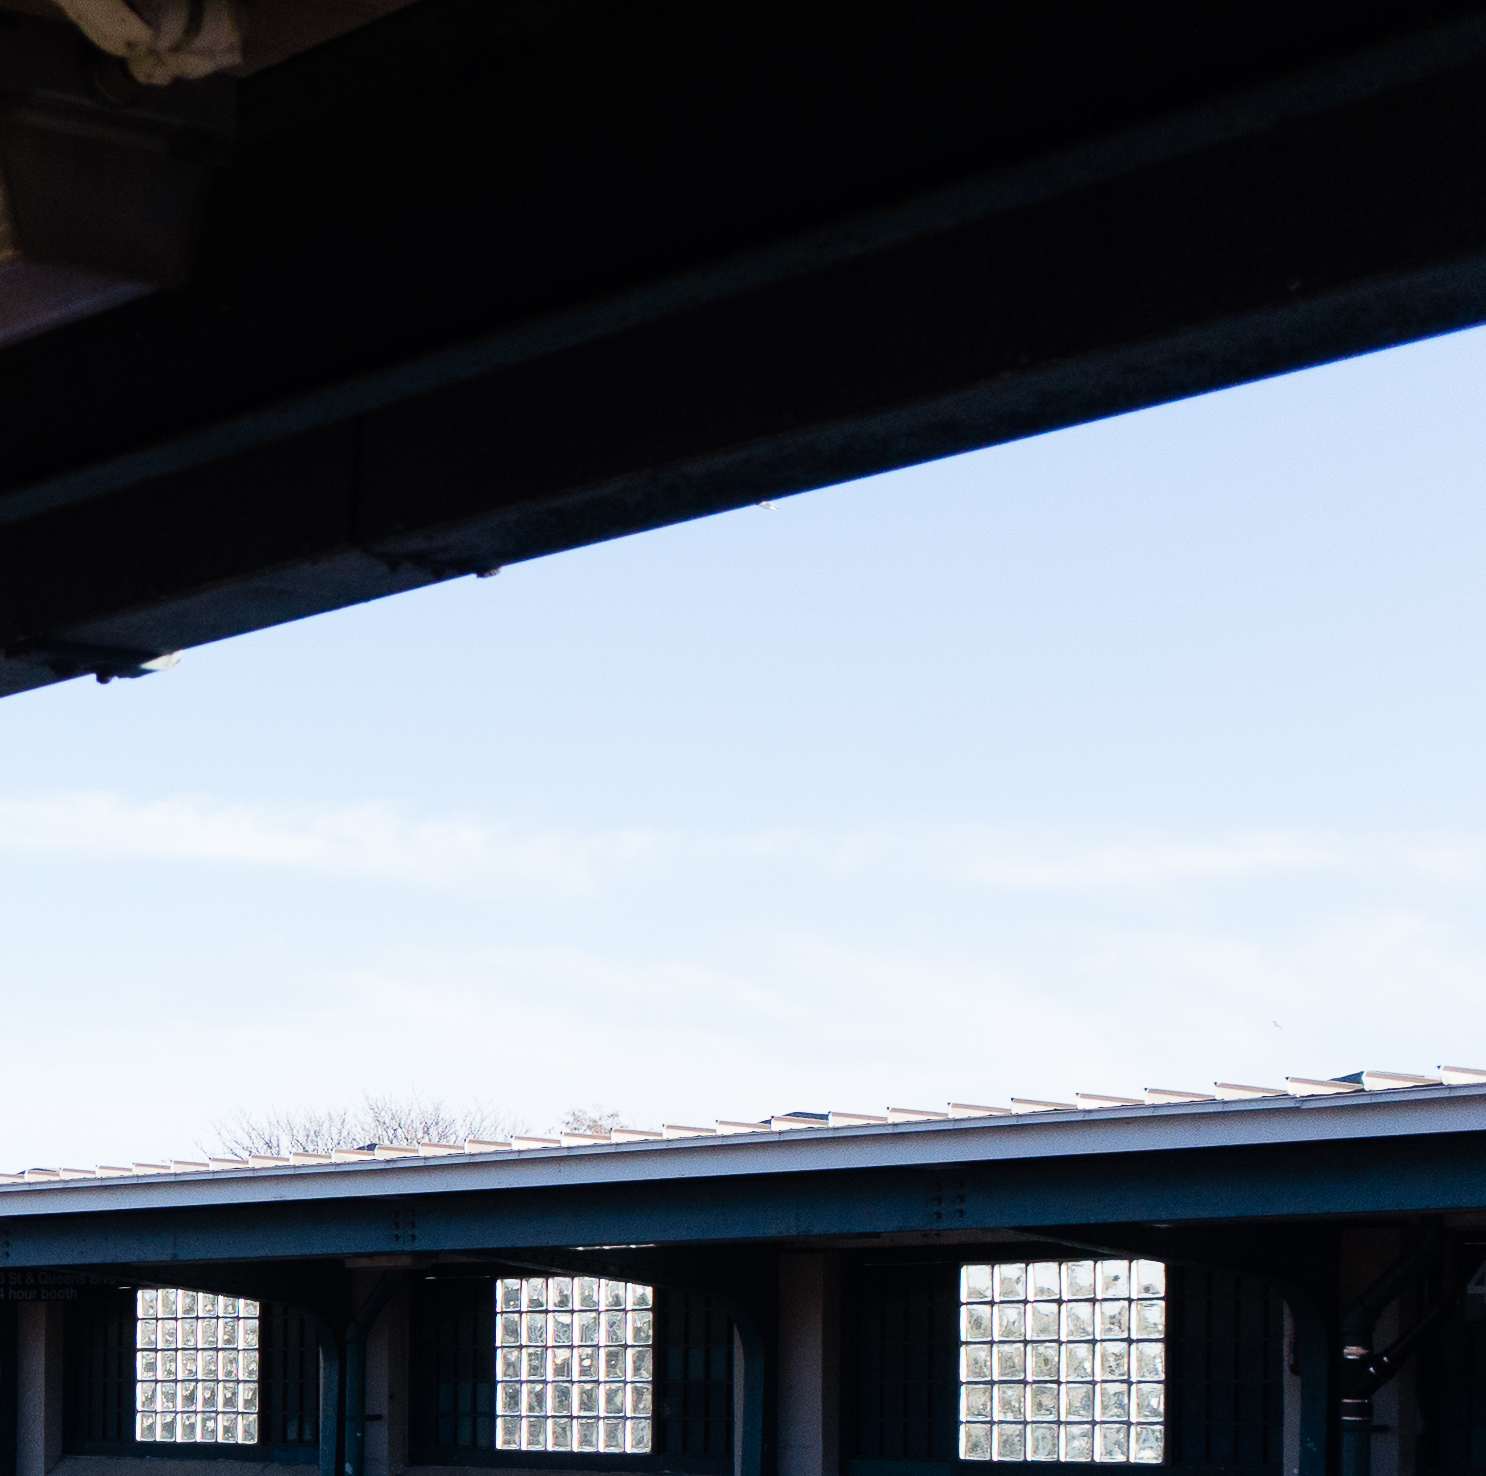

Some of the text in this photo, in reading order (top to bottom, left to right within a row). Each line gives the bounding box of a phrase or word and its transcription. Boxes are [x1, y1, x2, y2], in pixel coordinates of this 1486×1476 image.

[8, 1271, 23, 1285] St
[37, 1271, 86, 1285] Queens
[8, 1287, 38, 1300] hour
[40, 1286, 78, 1300] booth
